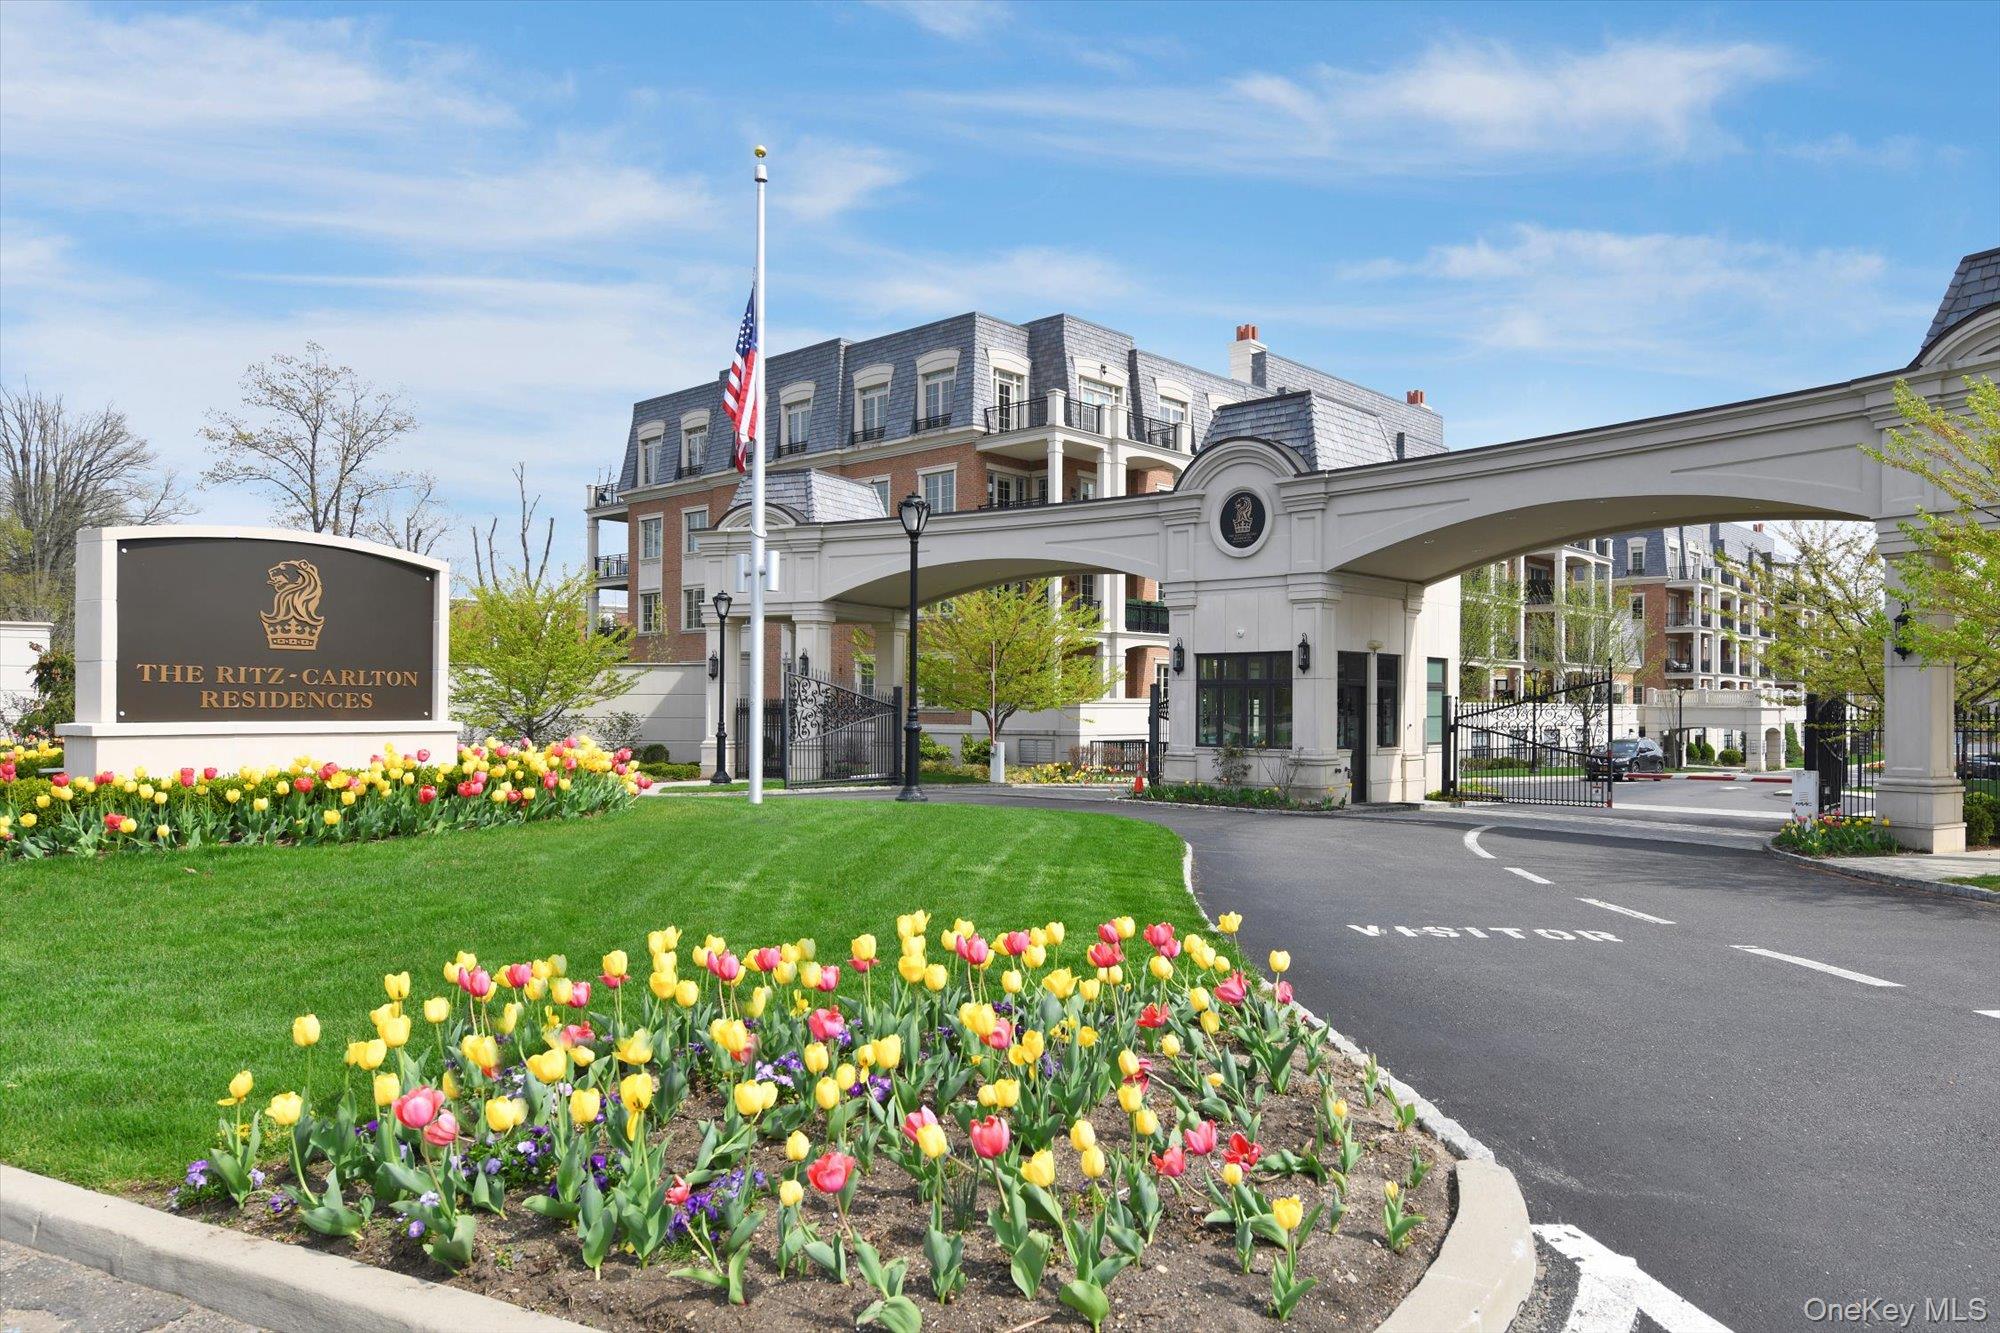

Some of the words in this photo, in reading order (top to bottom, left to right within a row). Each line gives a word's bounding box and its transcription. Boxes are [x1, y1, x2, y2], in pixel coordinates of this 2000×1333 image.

[136, 663, 205, 684] THE
[200, 691, 374, 710] RESIDENCES
[1346, 924, 1624, 942] VISITOR
